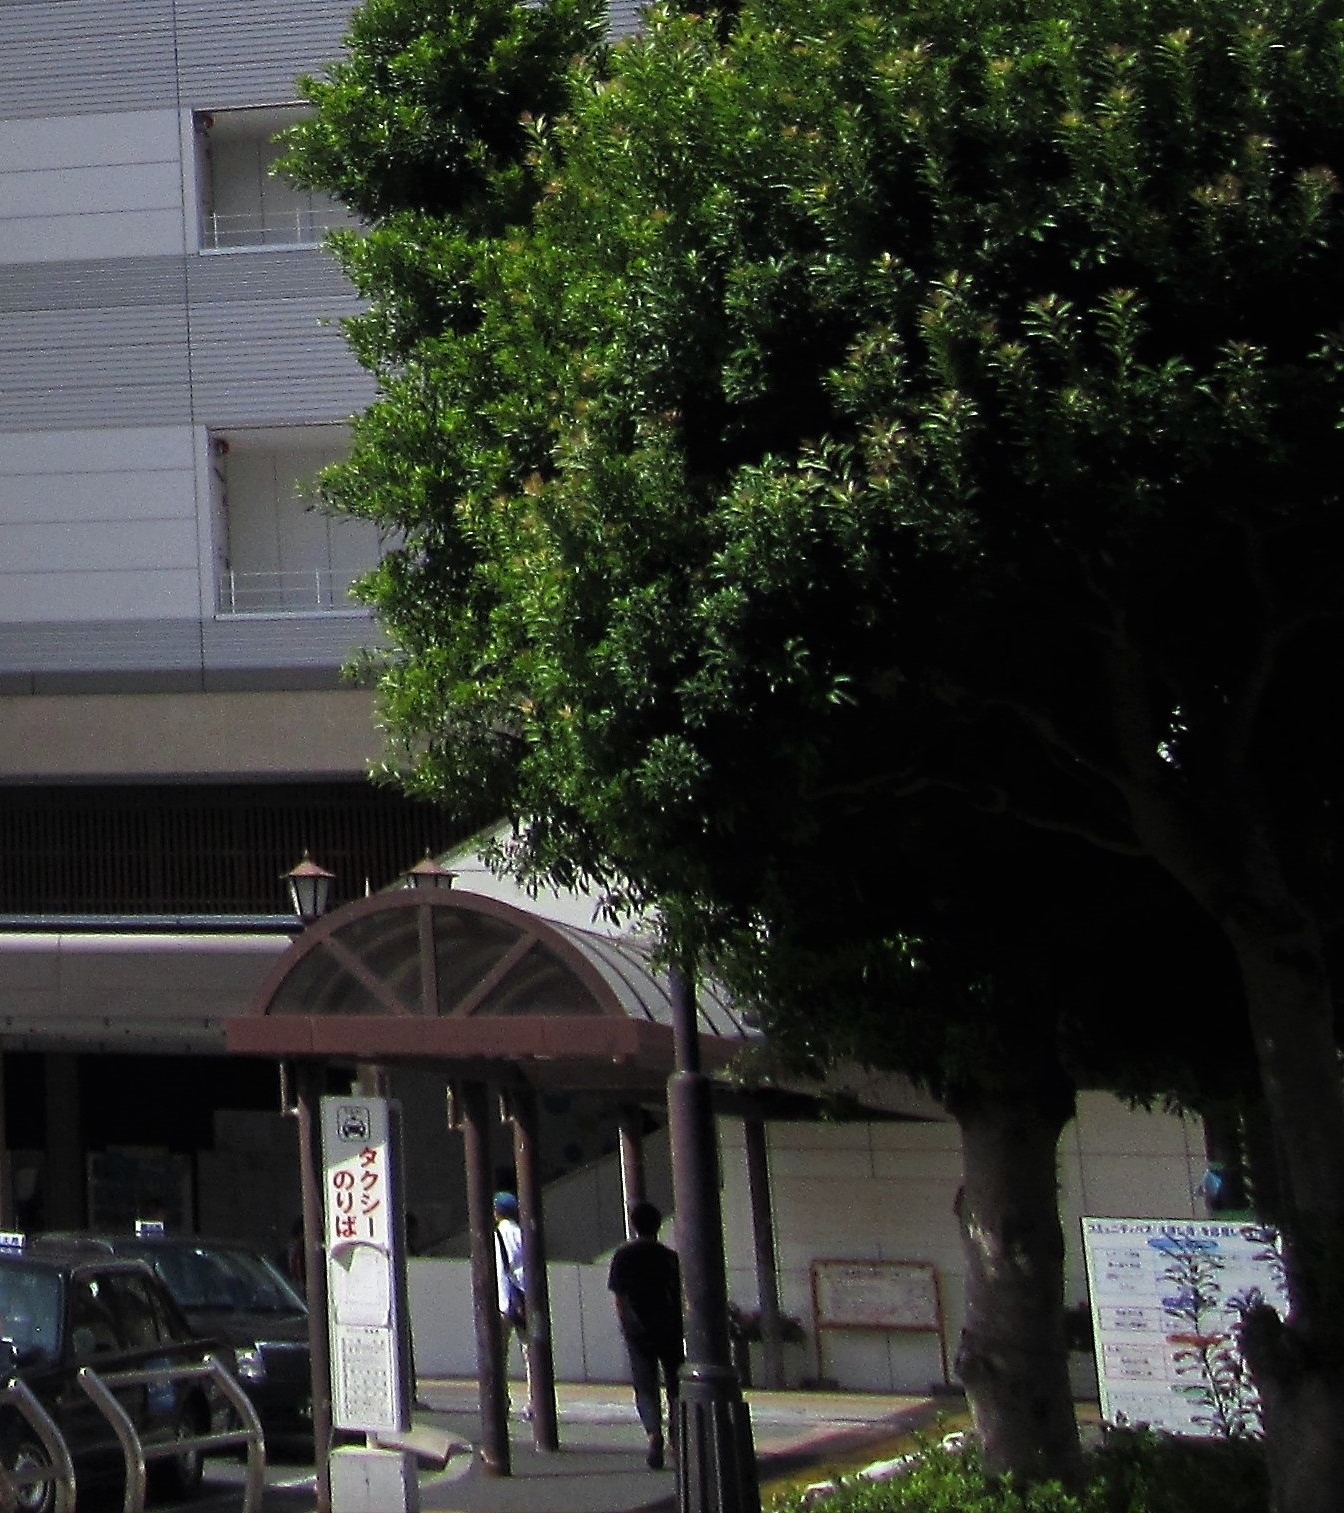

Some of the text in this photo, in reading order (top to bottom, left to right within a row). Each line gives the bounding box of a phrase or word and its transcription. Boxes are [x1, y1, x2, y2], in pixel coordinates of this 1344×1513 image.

[333, 1170, 358, 1239] のりば
[360, 1146, 381, 1239] タクシー
